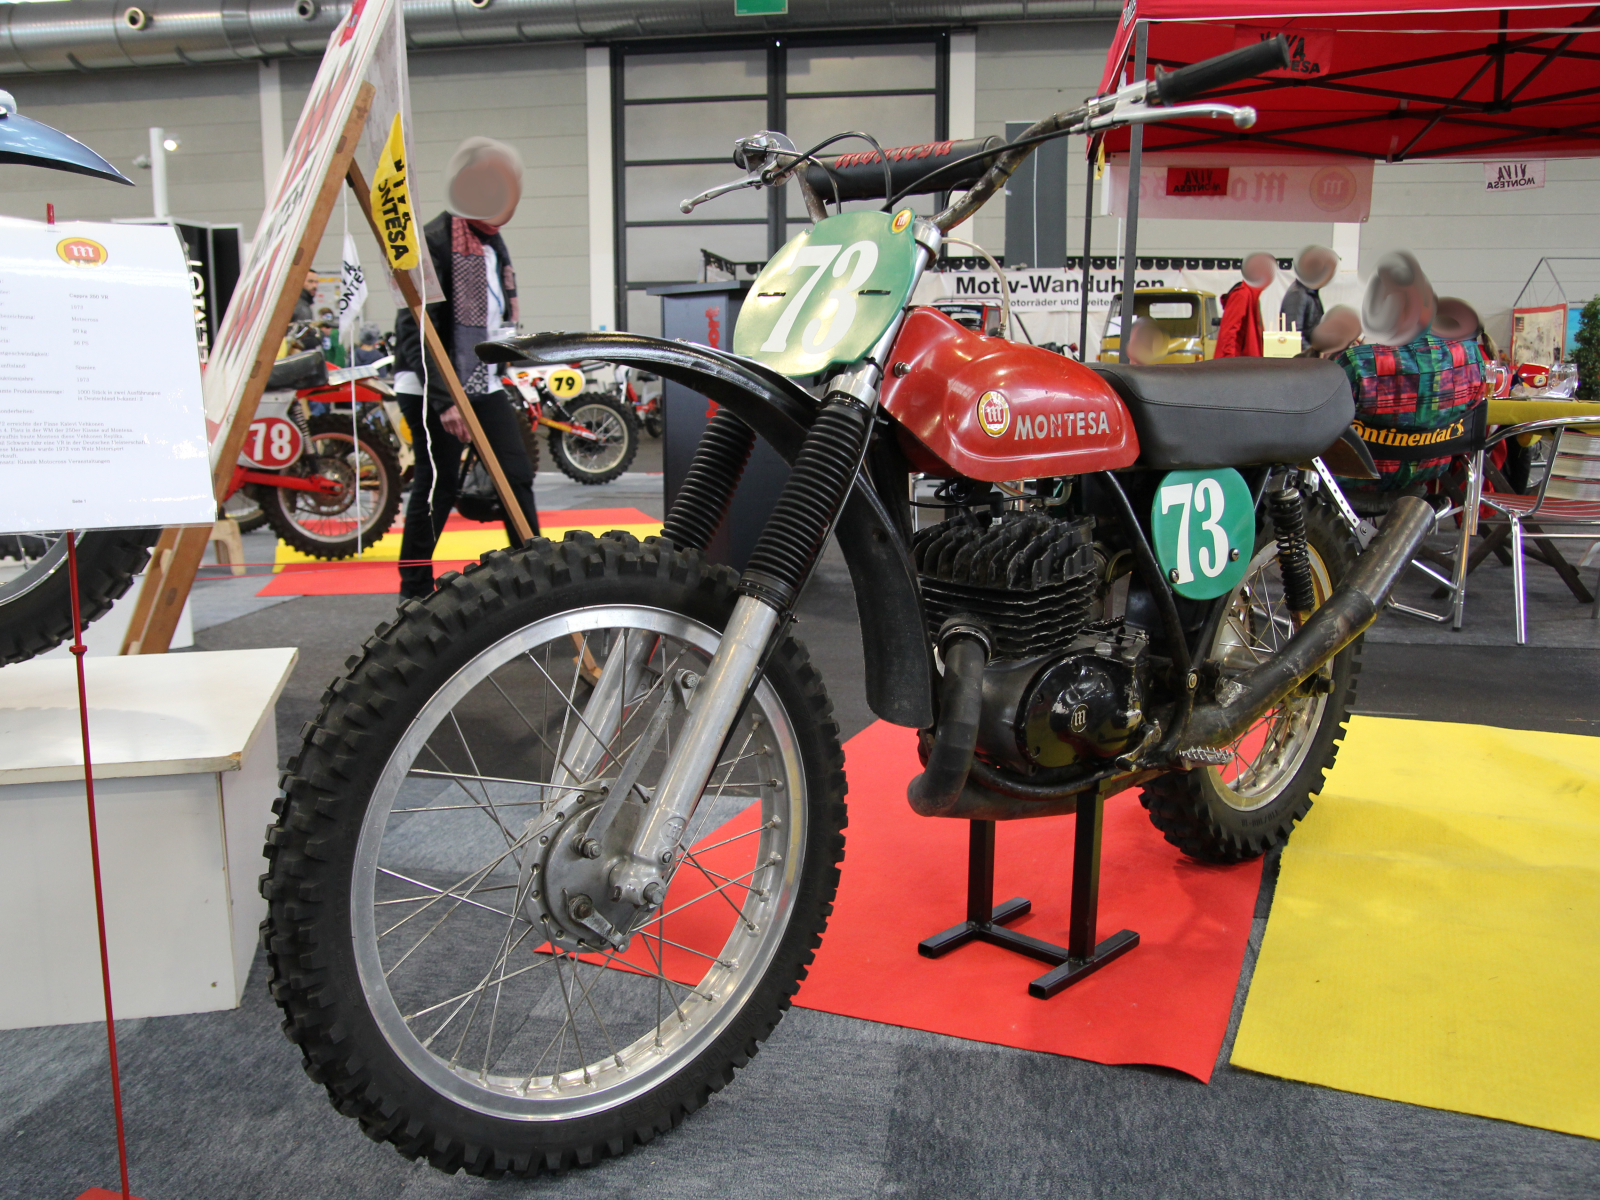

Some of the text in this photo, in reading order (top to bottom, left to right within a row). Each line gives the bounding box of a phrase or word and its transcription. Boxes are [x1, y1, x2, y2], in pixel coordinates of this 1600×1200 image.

[377, 178, 410, 262] ONTESA
[760, 240, 879, 354] 73
[956, 275, 1165, 294] Motv-Wanduhen
[1060, 298, 1079, 306] und
[554, 376, 576, 391] 79
[1014, 411, 1111, 441] MONTESA
[1353, 420, 1455, 447] ontinental
[249, 422, 293, 461] 78
[1160, 478, 1229, 585] 73
